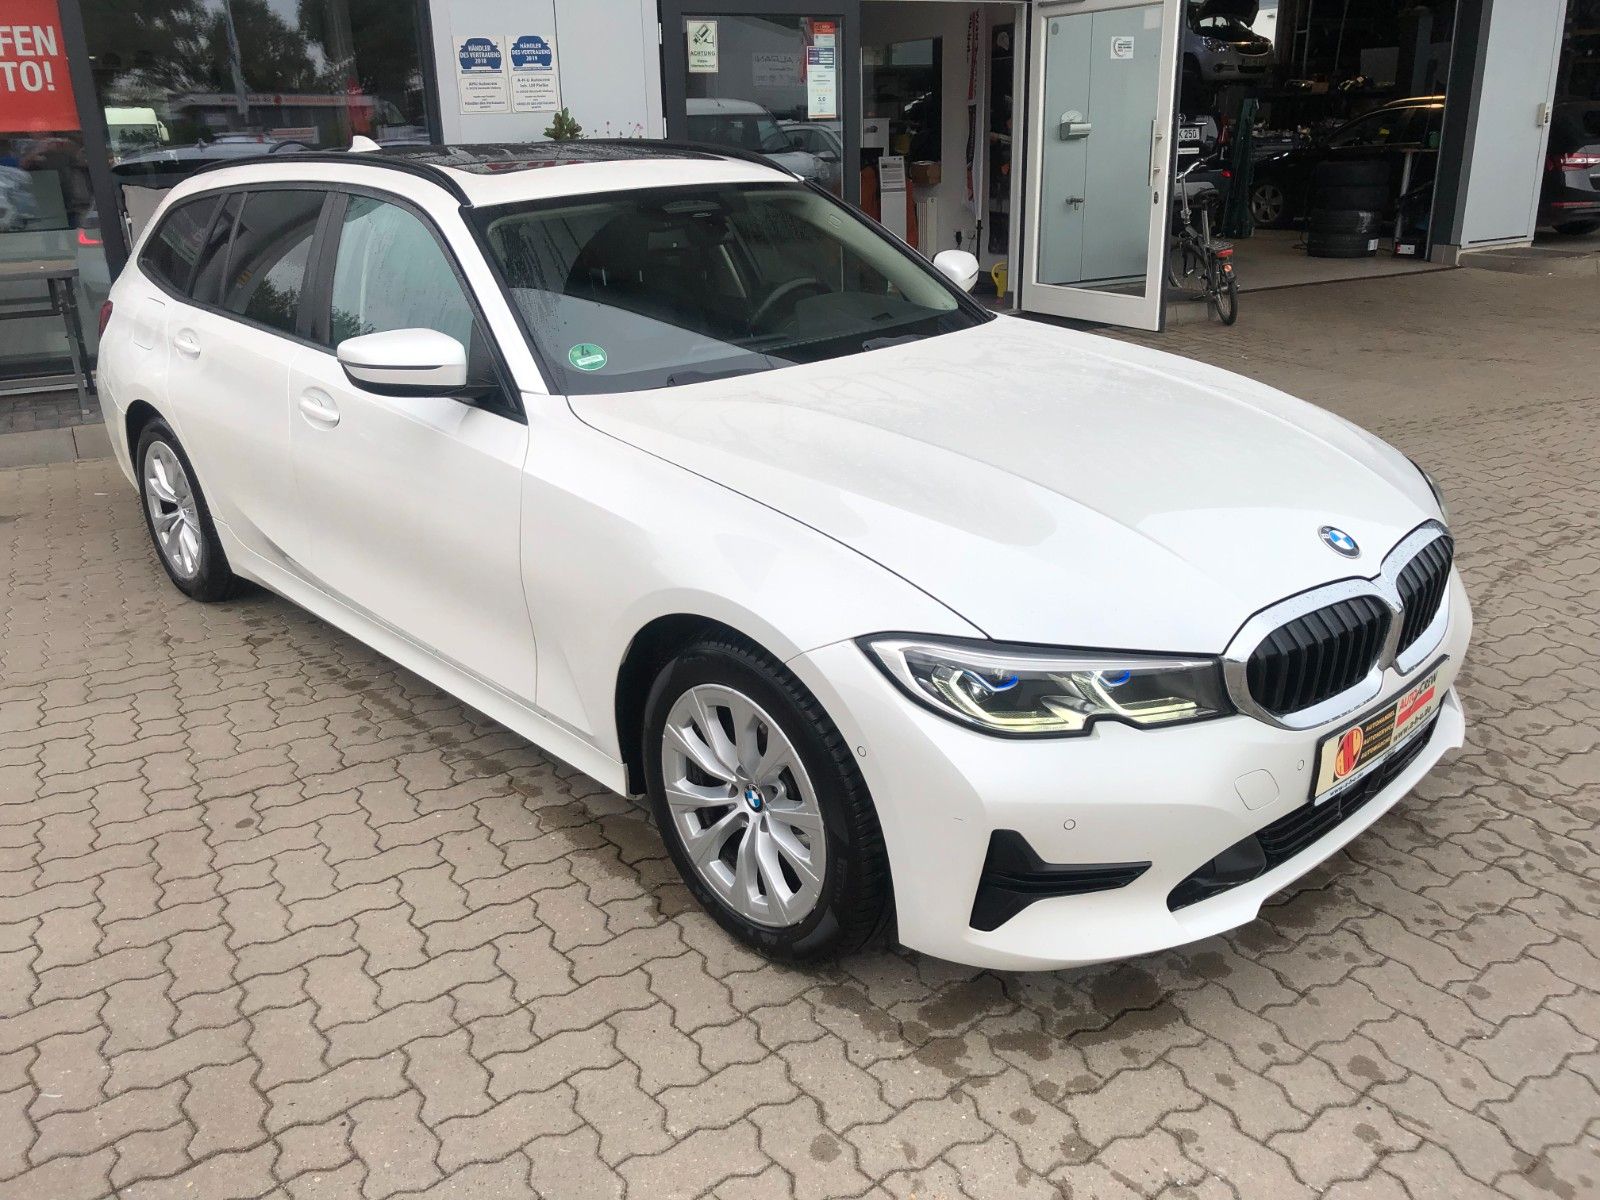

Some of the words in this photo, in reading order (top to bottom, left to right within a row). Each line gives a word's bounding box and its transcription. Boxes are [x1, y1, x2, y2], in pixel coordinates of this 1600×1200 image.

[467, 44, 491, 52] HÄNDLER
[470, 51, 501, 59] VERTRAUENS
[1184, 129, 1197, 139] 250
